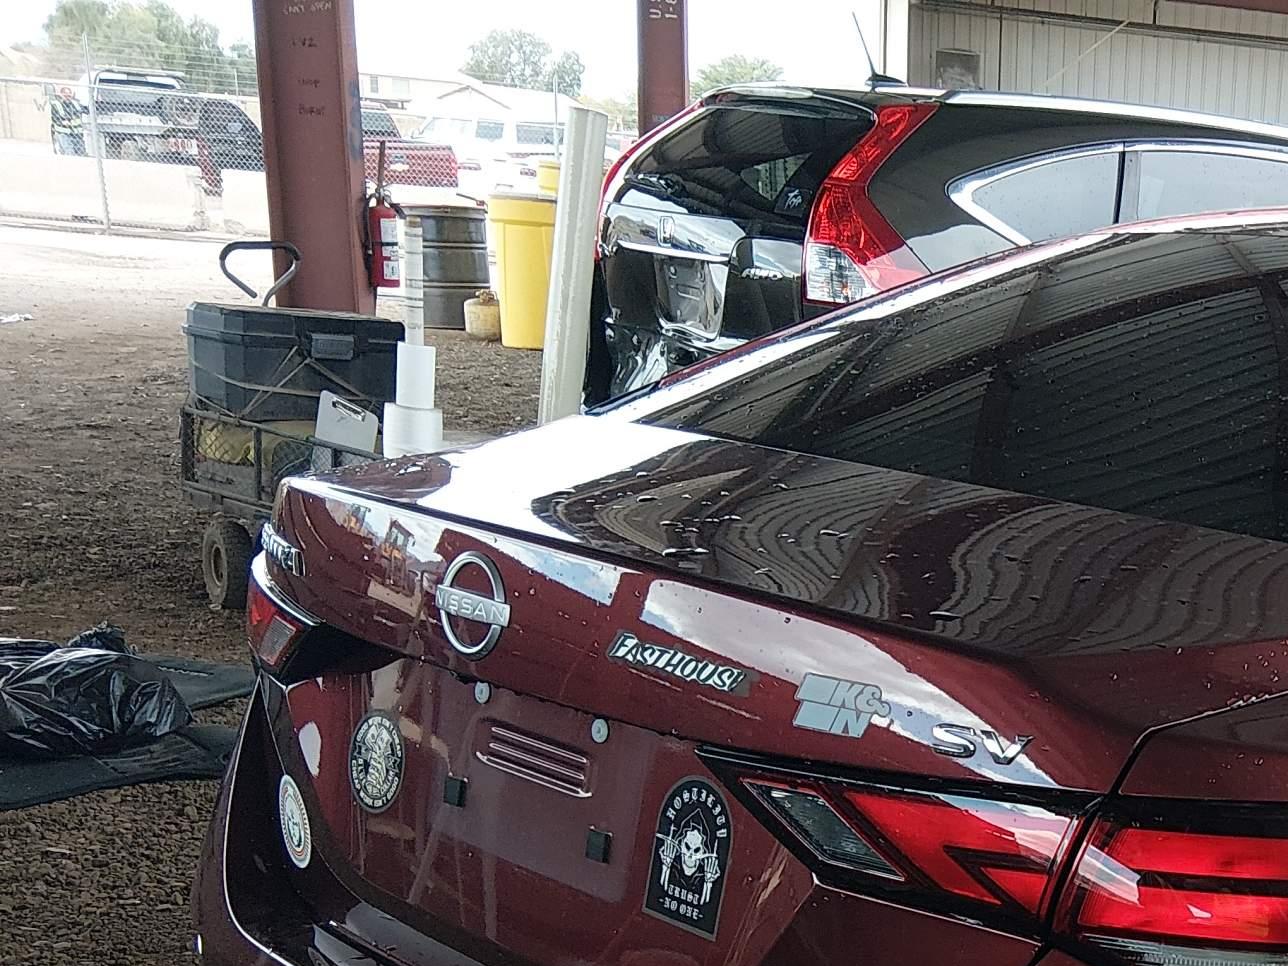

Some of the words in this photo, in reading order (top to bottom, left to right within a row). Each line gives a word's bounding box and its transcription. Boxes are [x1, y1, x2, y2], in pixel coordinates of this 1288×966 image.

[741, 268, 784, 280] AWD
[436, 589, 506, 623] NISSAN
[932, 722, 1035, 765] SV
[666, 787, 727, 838] HOSTILITY
[668, 884, 700, 905] TRUST
